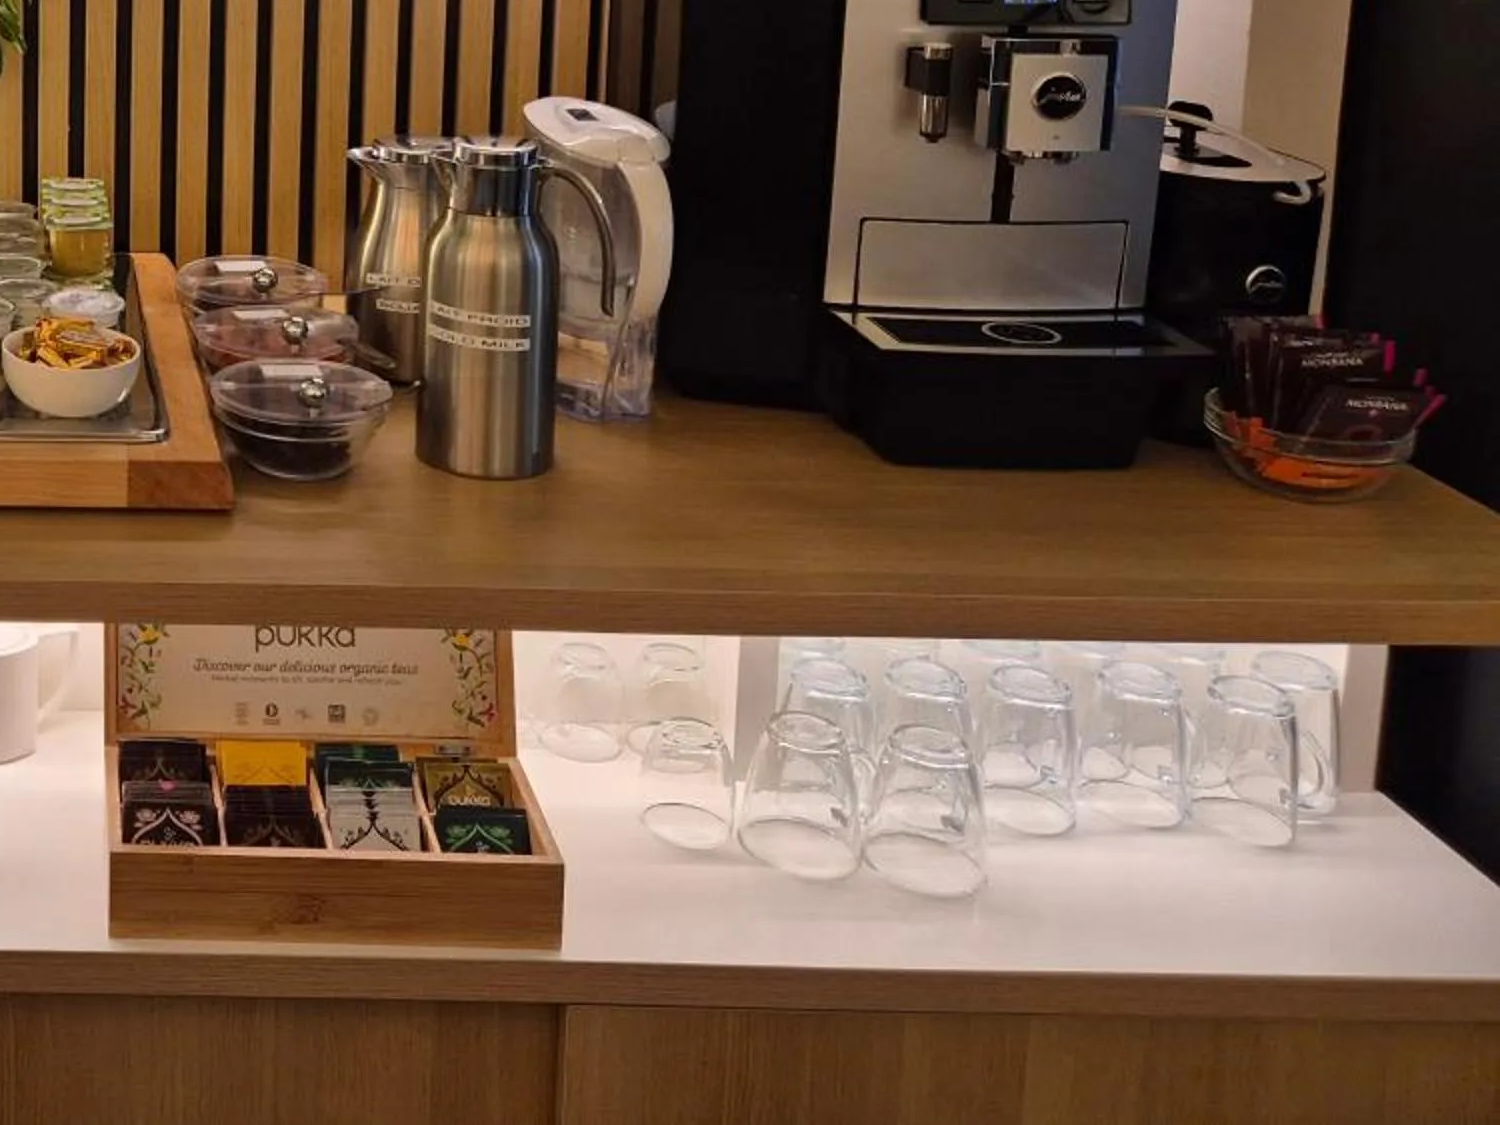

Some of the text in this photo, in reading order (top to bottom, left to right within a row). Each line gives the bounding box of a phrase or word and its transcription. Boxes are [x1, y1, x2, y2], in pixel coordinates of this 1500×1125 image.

[255, 625, 357, 653] pukka
[193, 658, 419, 678] Discover our delicious organic teas
